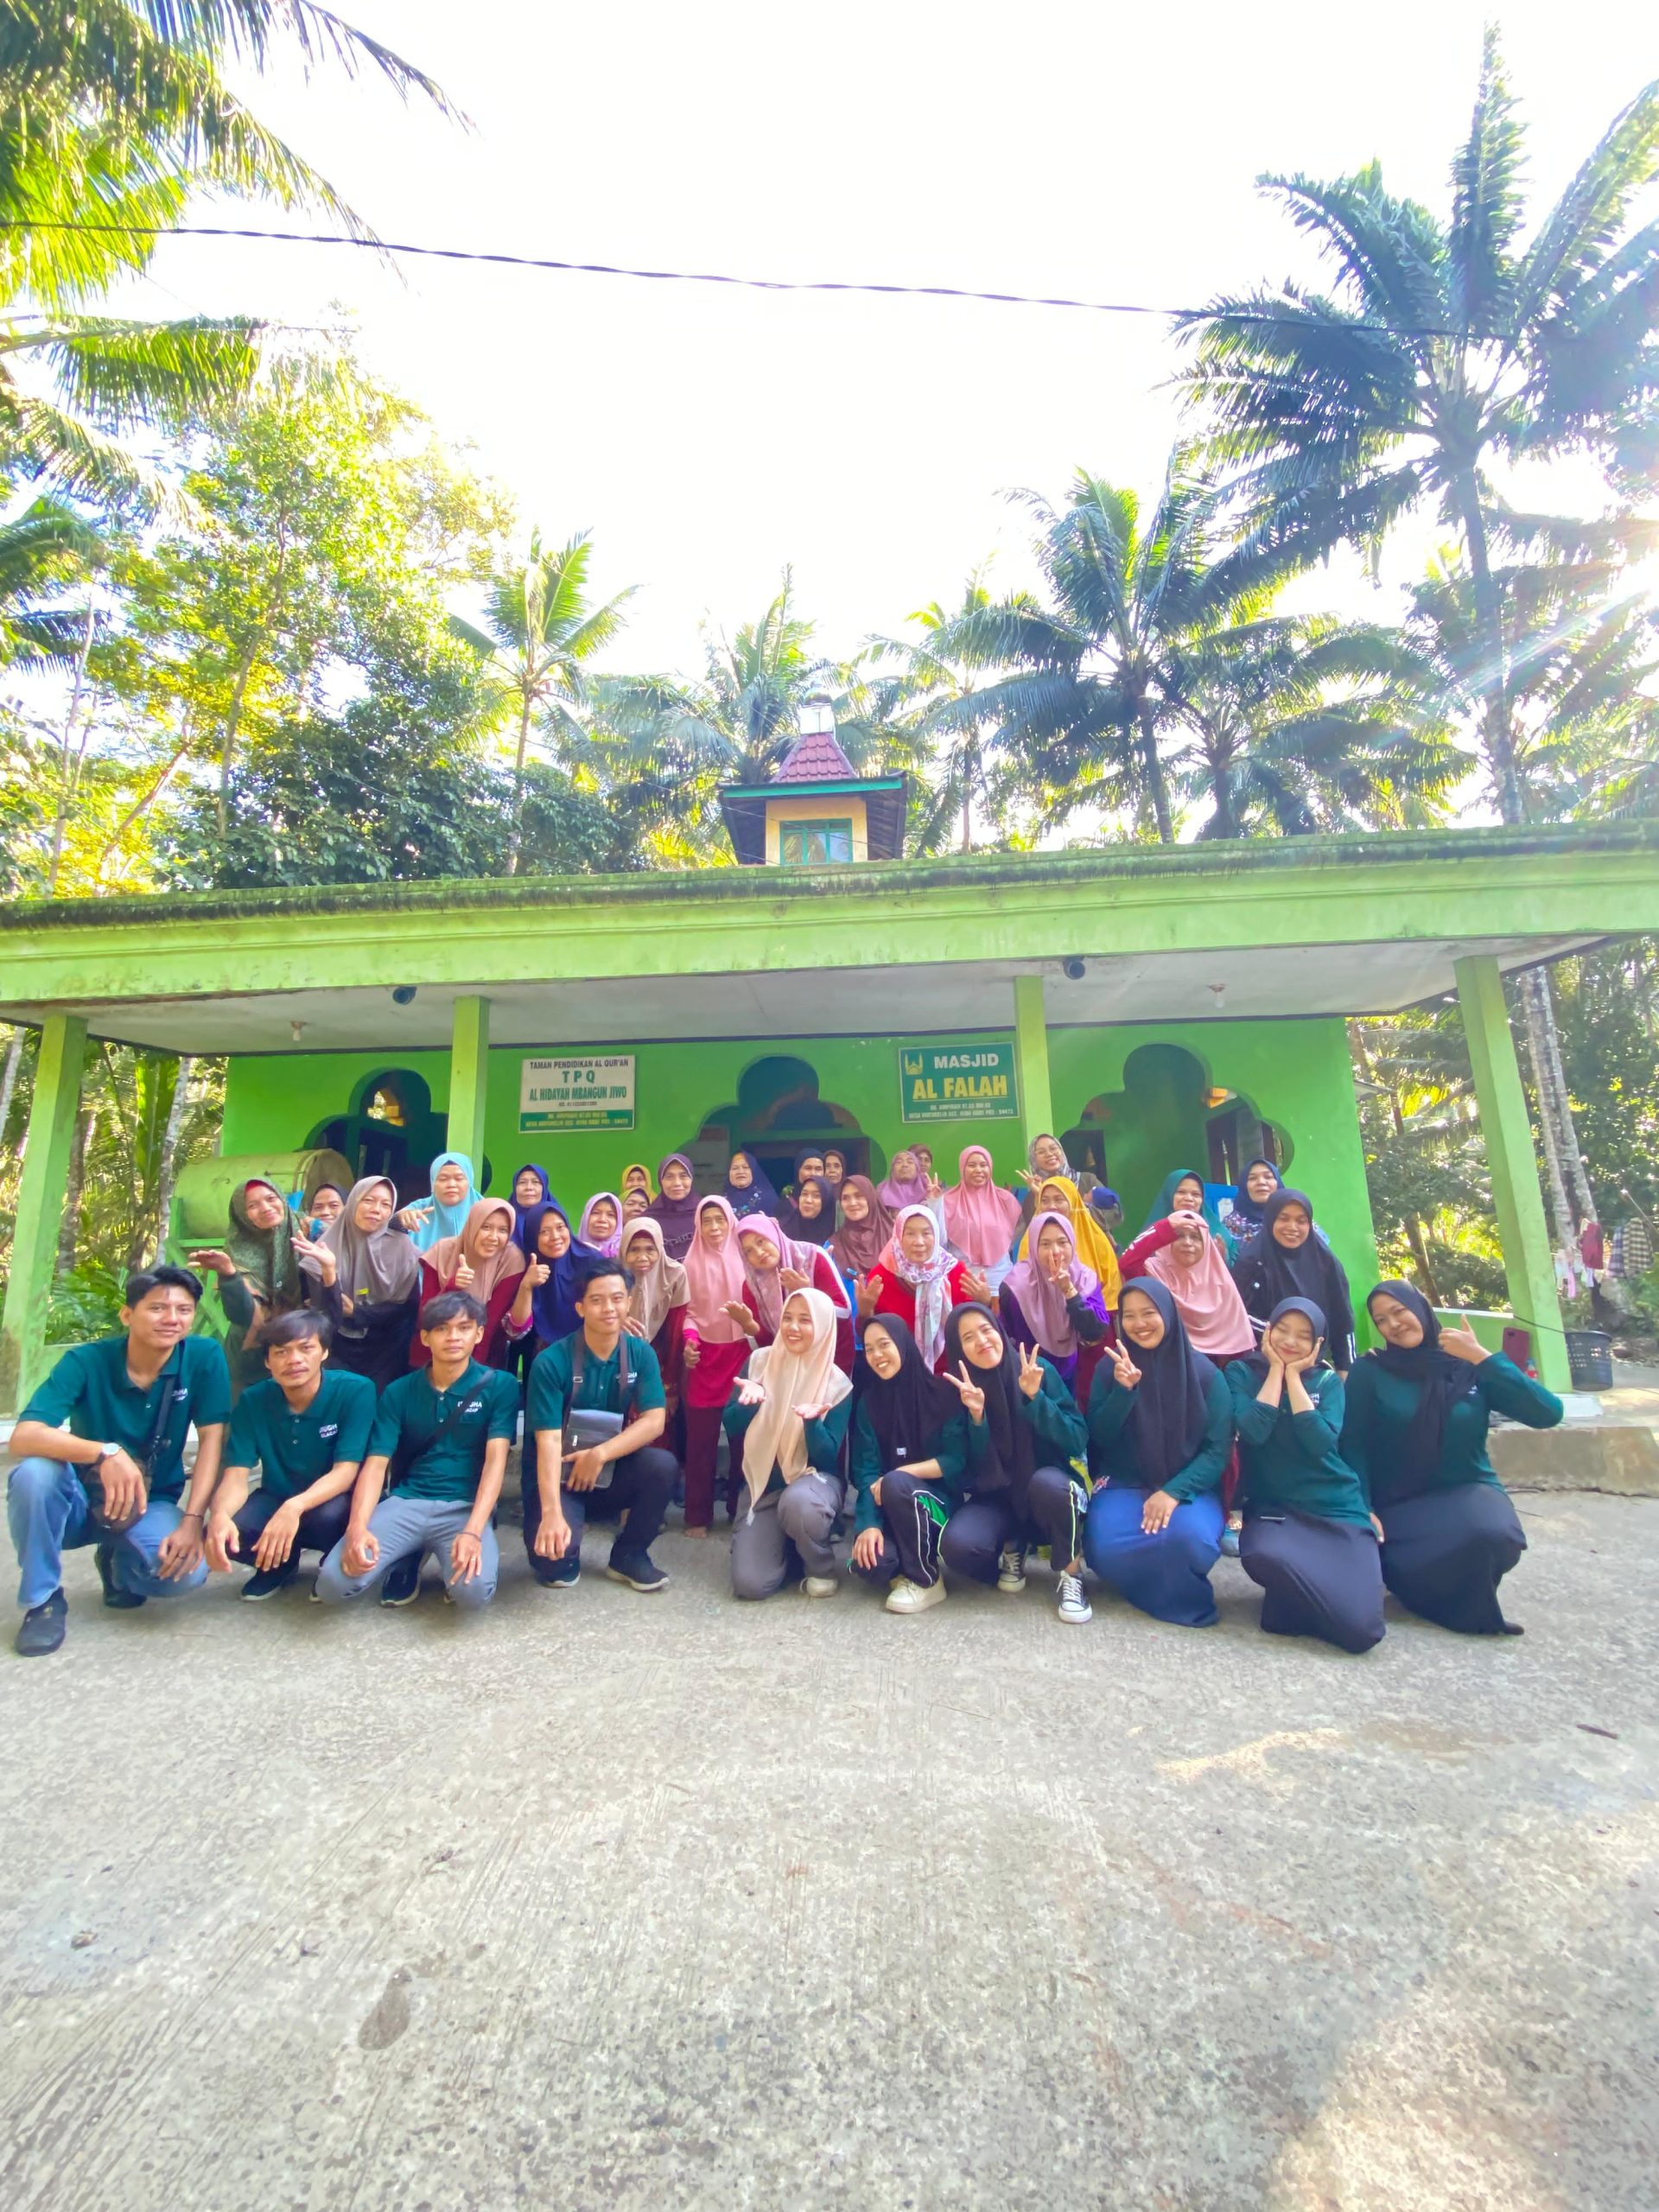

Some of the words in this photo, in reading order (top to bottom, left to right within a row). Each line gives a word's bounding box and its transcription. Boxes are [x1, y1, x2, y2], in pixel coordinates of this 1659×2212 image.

[554, 1060, 593, 1069] PENDIDIKAN
[594, 1059, 602, 1068] AL
[604, 1058, 629, 1067] QUR'AN
[934, 1053, 999, 1069] MASJID
[530, 1089, 537, 1101] AL
[539, 1087, 570, 1101] HIDAYAH
[609, 1085, 626, 1098] JIWO
[912, 1078, 938, 1100] AL
[944, 1075, 1007, 1098] FALAH
